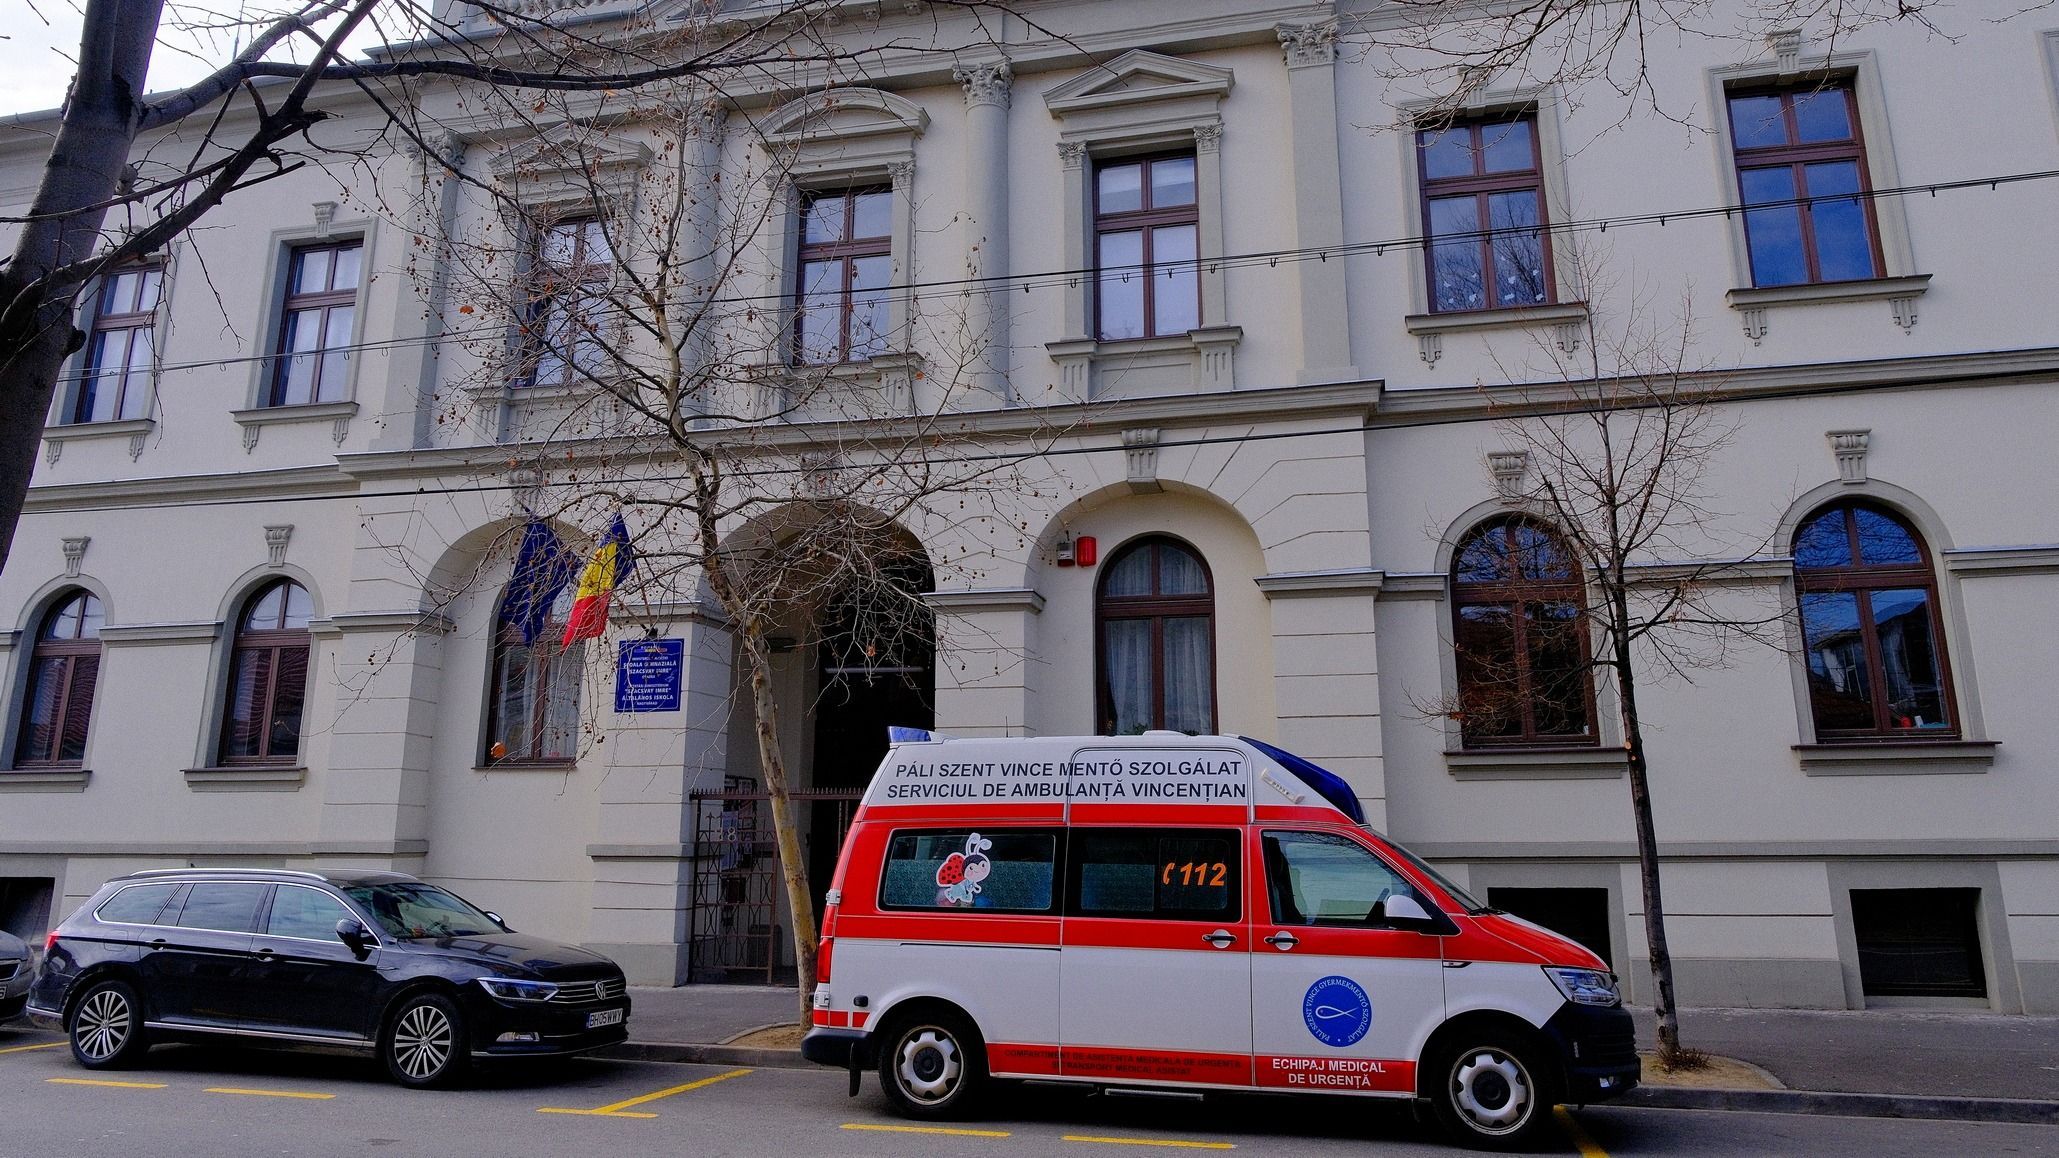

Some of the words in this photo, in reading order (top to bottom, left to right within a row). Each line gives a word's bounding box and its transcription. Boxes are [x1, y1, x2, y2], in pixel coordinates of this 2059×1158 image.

[896, 761, 934, 777] PÁLI
[938, 764, 995, 776] SZENT
[1001, 763, 1053, 776] VINCE
[1059, 759, 1123, 776] MENTŐ
[1129, 758, 1241, 776] SZOLGÁLAT
[887, 784, 977, 798] SERVICIUL
[983, 784, 1006, 797] DE
[1011, 780, 1126, 801] AMBULANȚĂ
[1132, 783, 1246, 802] VINCENȚIAN
[1180, 863, 1226, 885] 112
[1306, 985, 1320, 1006] VINCE
[1305, 1007, 1319, 1031] SZENT
[1316, 1030, 1330, 1042] PÁLI
[1272, 1058, 1324, 1070] ECHIPAJ
[1328, 1060, 1386, 1072] MEDICAL
[1288, 1074, 1305, 1084] DE
[1309, 1074, 1371, 1088] URGENȚĂ
